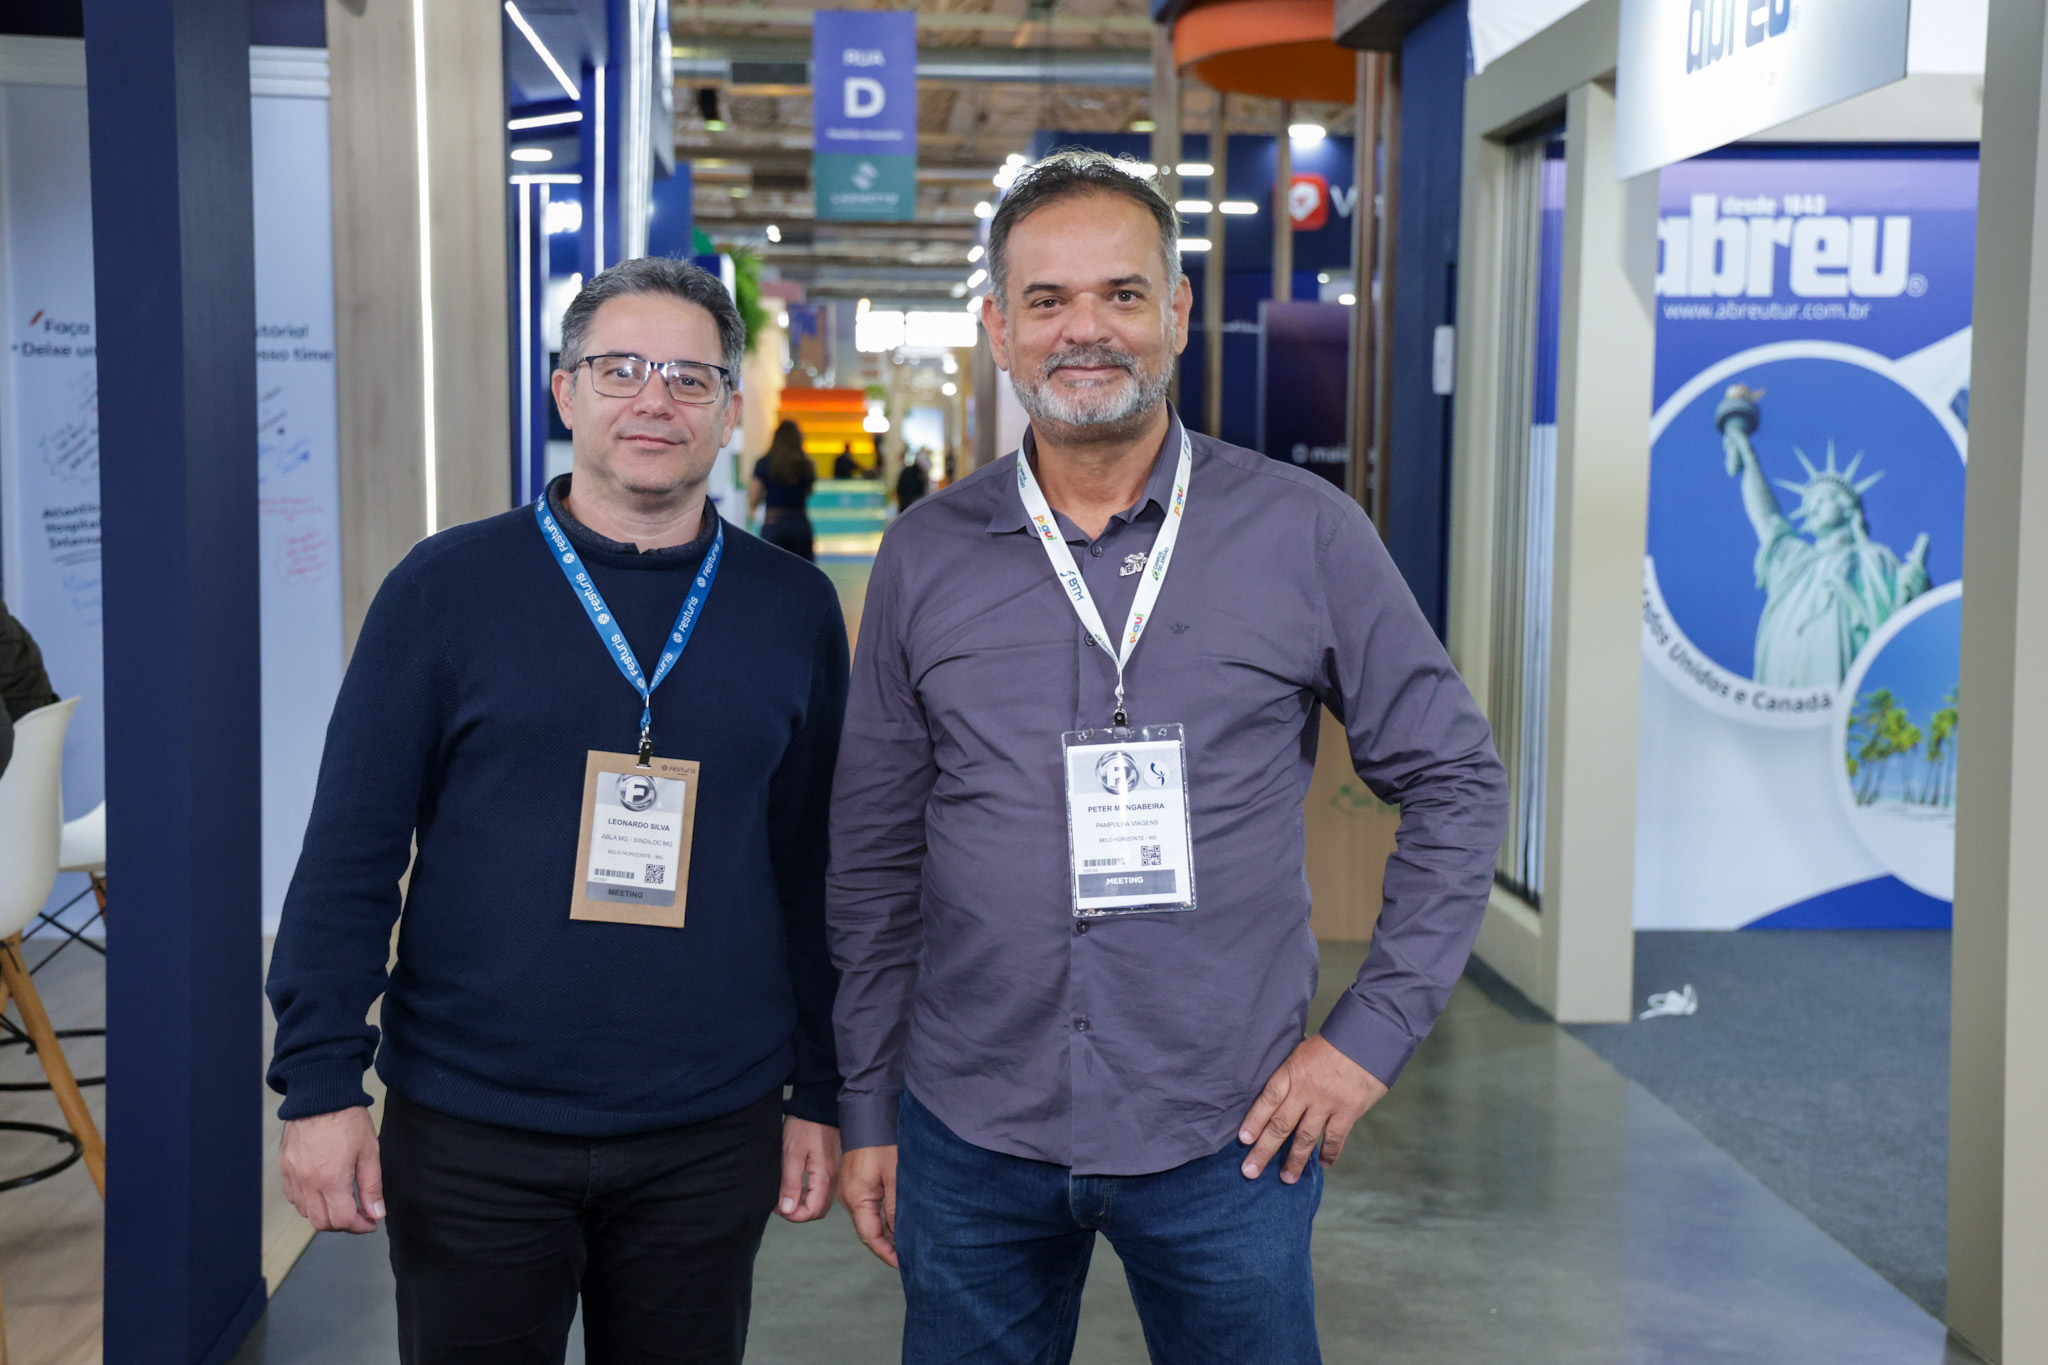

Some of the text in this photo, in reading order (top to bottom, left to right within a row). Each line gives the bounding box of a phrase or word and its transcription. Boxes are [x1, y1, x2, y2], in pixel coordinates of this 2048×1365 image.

[842, 48, 886, 67] RUA
[844, 77, 886, 119] D
[1662, 300, 1872, 321] www.abreutur.com.br
[293, 345, 333, 362] time
[543, 515, 569, 553] Festuris
[703, 542, 721, 578] Festuris
[575, 571, 604, 613] Festuris
[1068, 577, 1085, 602] BTM
[678, 595, 699, 633] Festuris
[610, 633, 639, 678] Festuris
[1667, 643, 1730, 698] Unidos
[1733, 689, 1747, 705] e
[1088, 803, 1165, 813] PETER MNGABEIRA
[607, 818, 670, 832] LEONARDO SILVA
[1131, 819, 1159, 827] VIAGENS
[633, 837, 662, 846] SINDILOC
[1106, 876, 1144, 886] MEETING
[608, 888, 644, 899] MEETING
